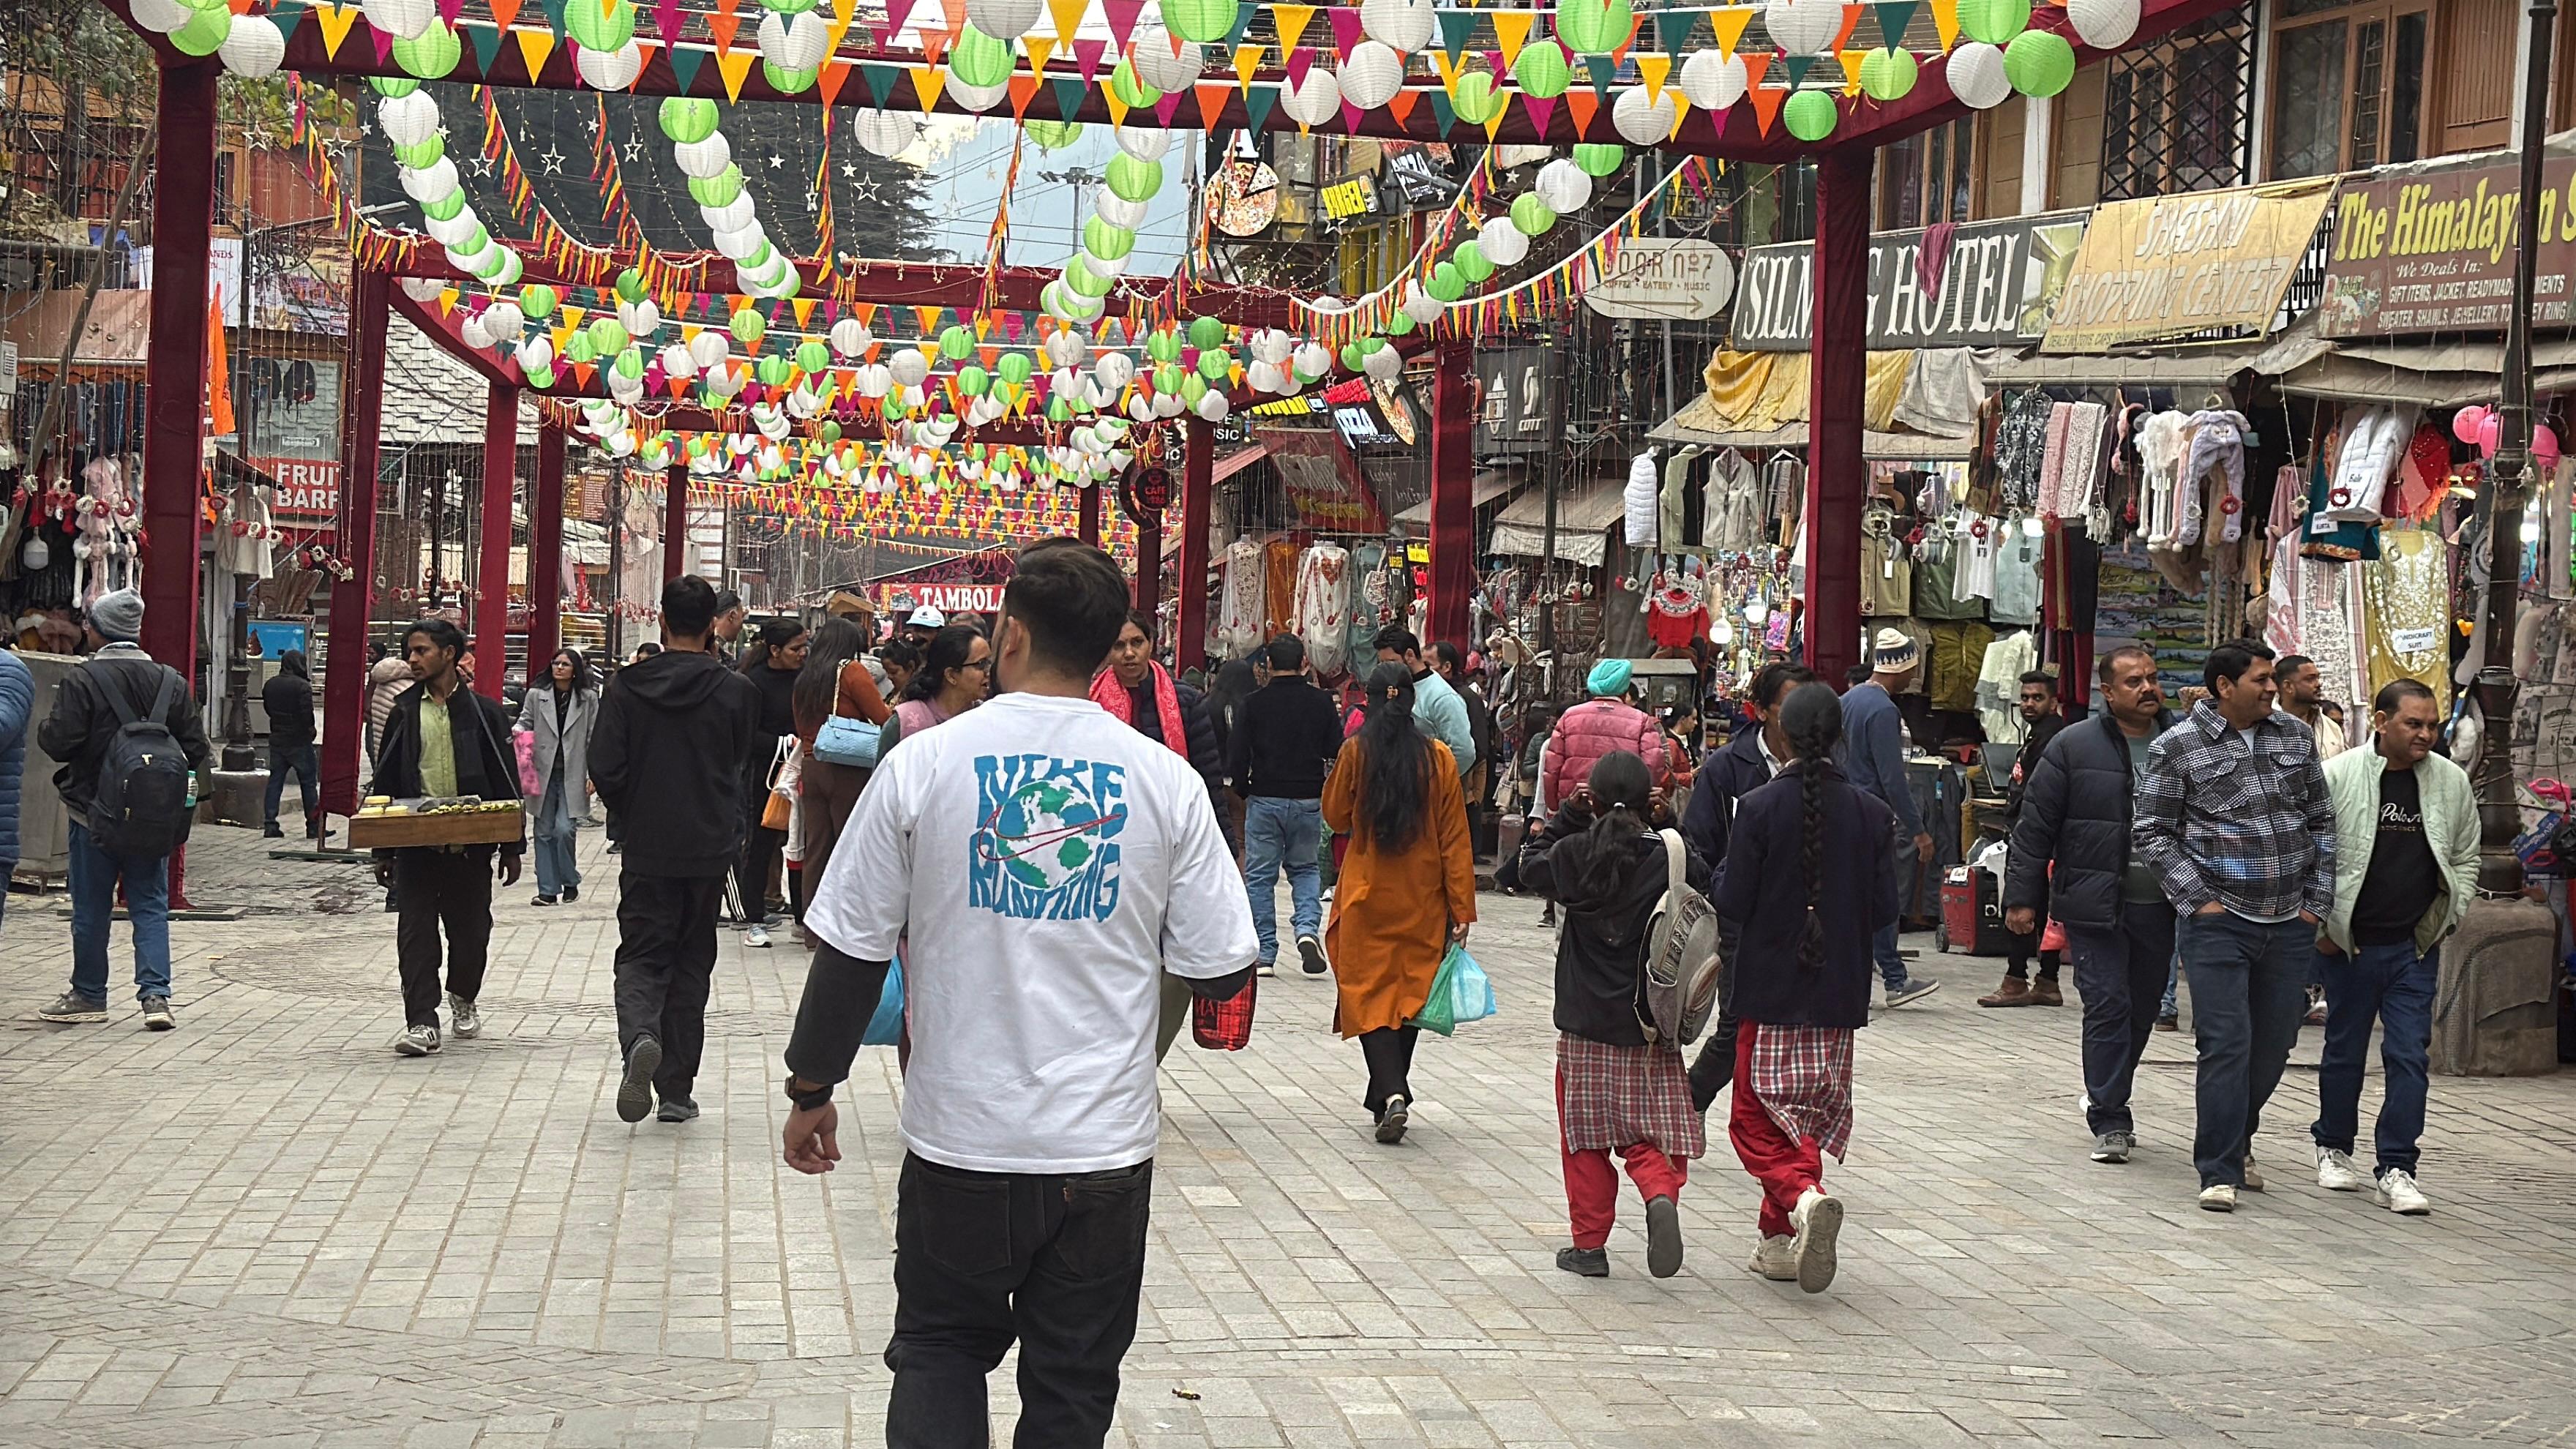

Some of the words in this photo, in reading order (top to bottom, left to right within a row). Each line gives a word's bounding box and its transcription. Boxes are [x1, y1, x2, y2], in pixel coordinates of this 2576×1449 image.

[2334, 191, 2388, 261] The
[2389, 177, 2557, 265] Himalayn
[1603, 280, 1631, 290] COFFEE
[1642, 280, 1673, 290] EATERY
[1684, 281, 1710, 292] MUSIC
[1885, 233, 2021, 337] HOTEL
[2055, 266, 2187, 328] SHOPPING
[2183, 256, 2291, 317] CENTER
[2389, 285, 2405, 303] GIFT
[2466, 278, 2514, 299] READYMAD
[2534, 274, 2565, 294] MENTS
[2397, 261, 2416, 278] We
[2421, 258, 2457, 277] Deals
[2532, 303, 2544, 321] EY
[277, 463, 340, 487] FRUI
[973, 754, 1128, 840] NIKE
[970, 828, 1121, 923] RUNNING
